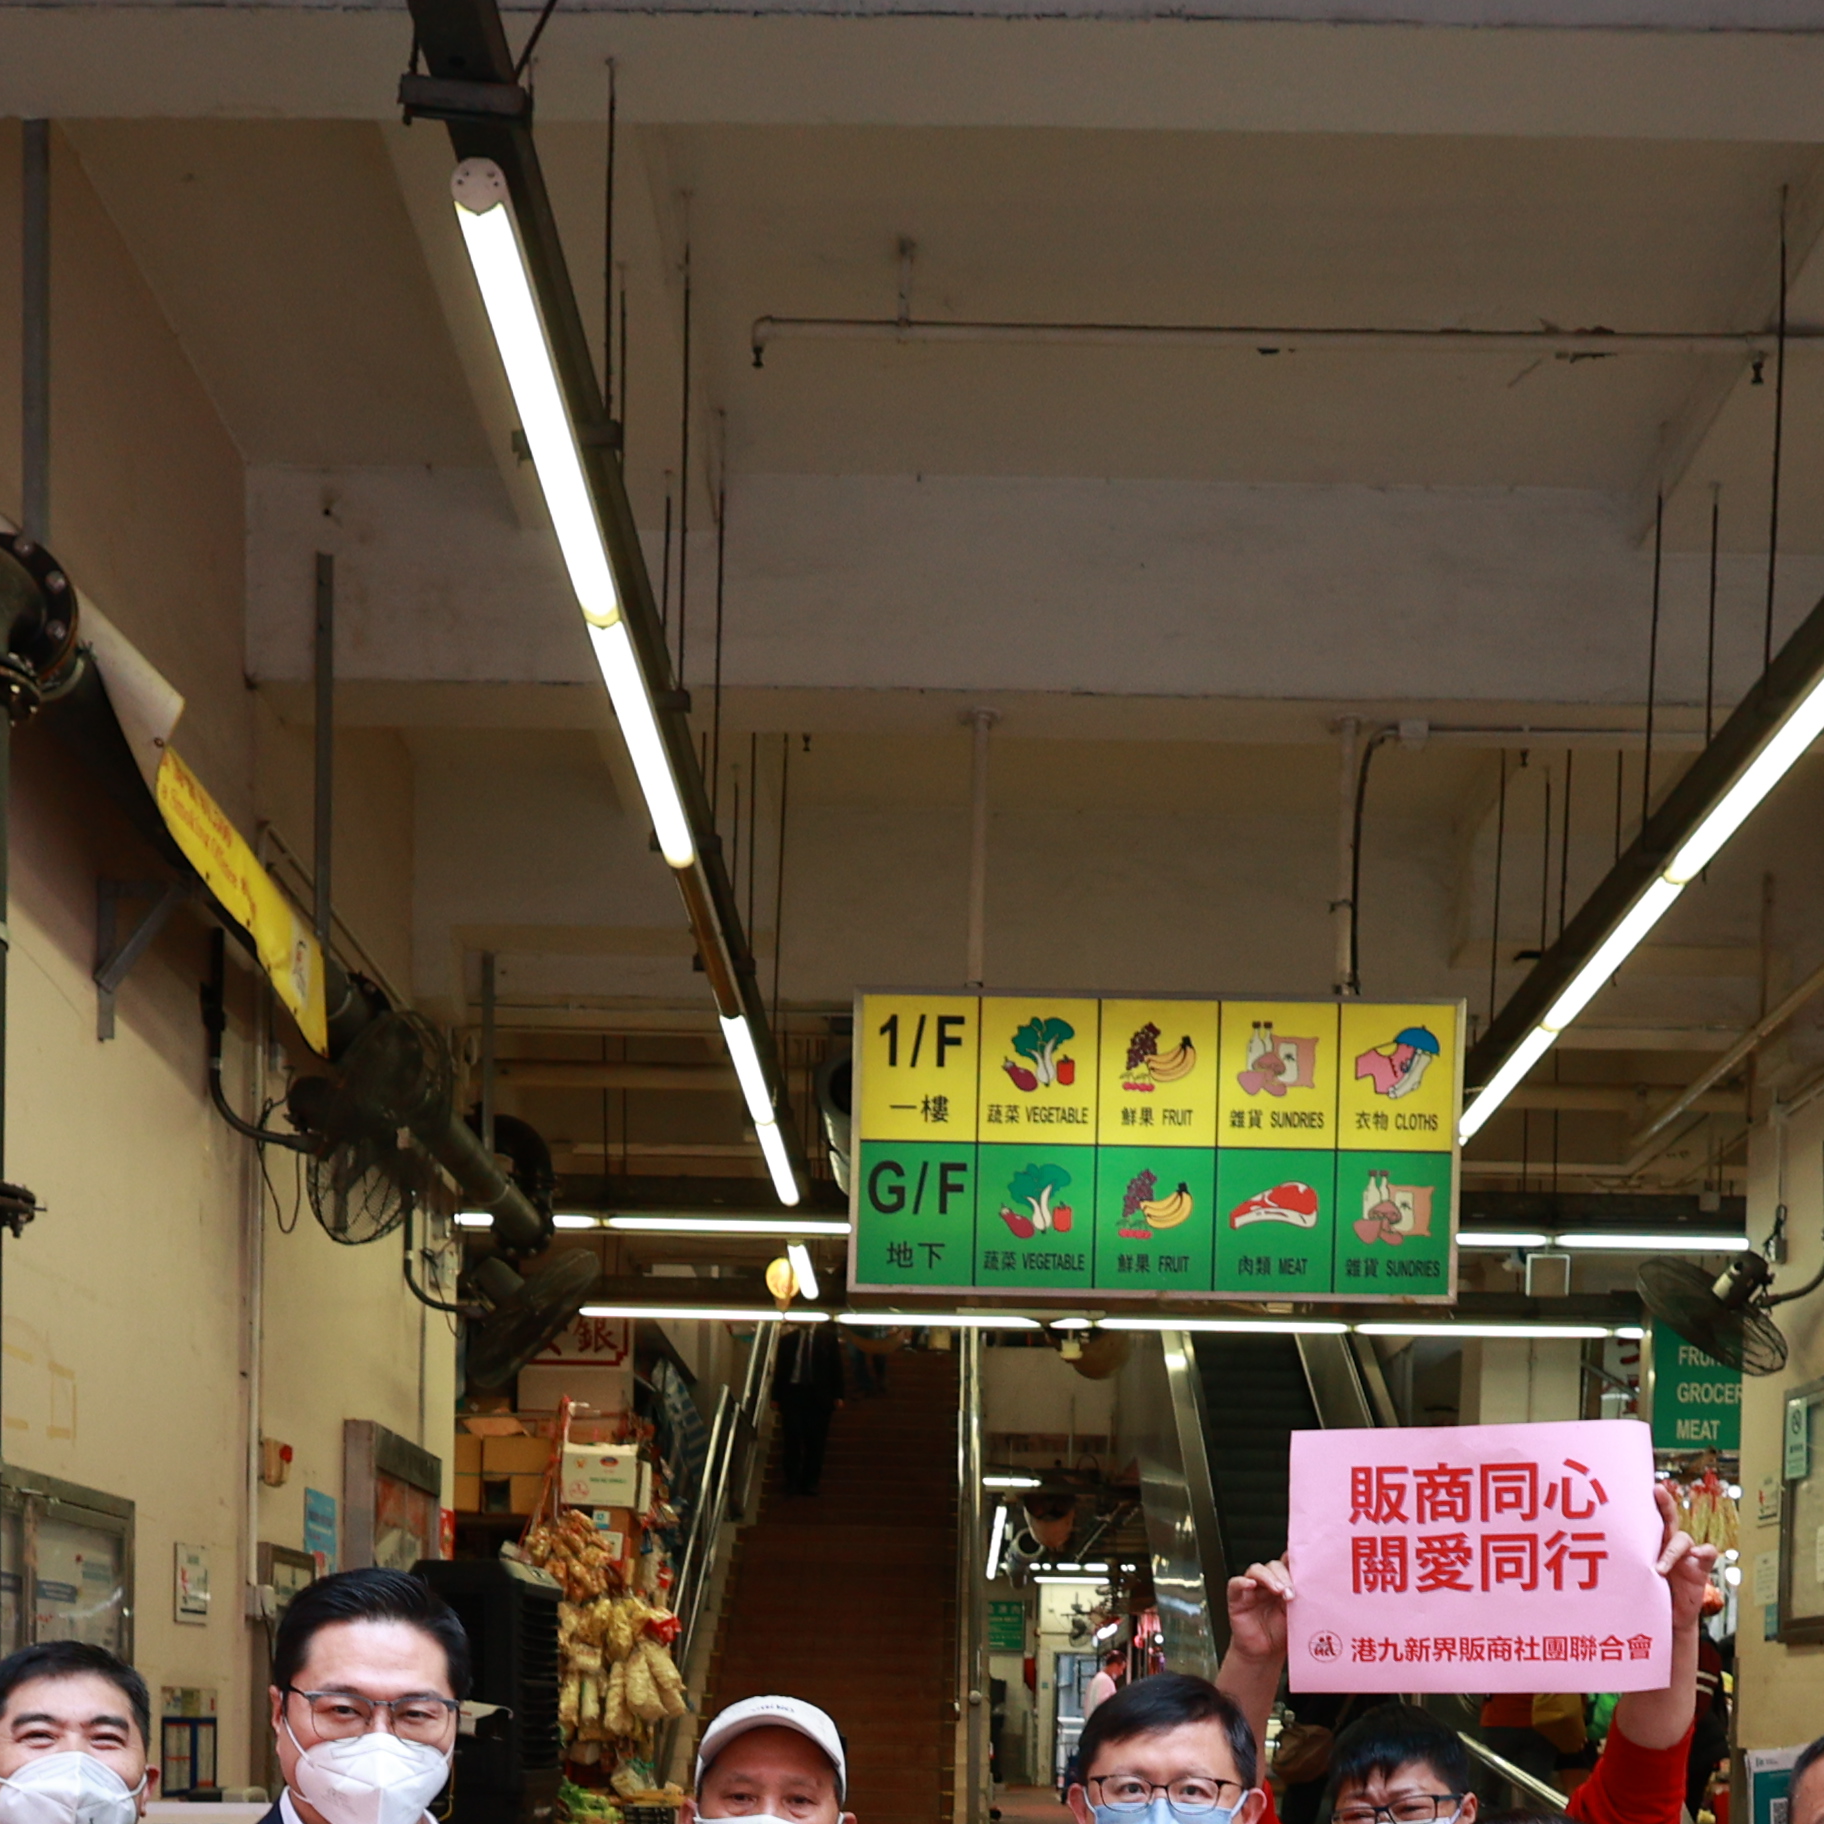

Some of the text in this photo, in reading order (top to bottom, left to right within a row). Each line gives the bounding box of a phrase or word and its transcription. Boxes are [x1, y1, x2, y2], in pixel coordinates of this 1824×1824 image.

[878, 1014, 965, 1069] 1/F
[889, 1093, 950, 1124] 一樓
[986, 1104, 1089, 1126] 蔬菜 VEGETABLE
[1120, 1107, 1193, 1127] 鮮果 FRUIT
[1229, 1109, 1325, 1130] 雜貨 SUNDRIES
[1354, 1111, 1439, 1132] 衣物 CLOTHS
[868, 1160, 968, 1215] G/F
[886, 1241, 946, 1269] 地下
[983, 1251, 1086, 1272] 蔬菜 VEGETABLE
[1117, 1254, 1190, 1275] 鮮果 FRUIT
[1238, 1256, 1308, 1276] 肉類 MEAT
[1345, 1258, 1441, 1279] 雜貨 SUNDRIES
[1676, 1419, 1721, 1440] MEAT
[1348, 1457, 1608, 1525] 販商同心
[1350, 1529, 1608, 1594] 關愛同行
[1350, 1632, 1654, 1664] 港九新界販商社團聯合會
